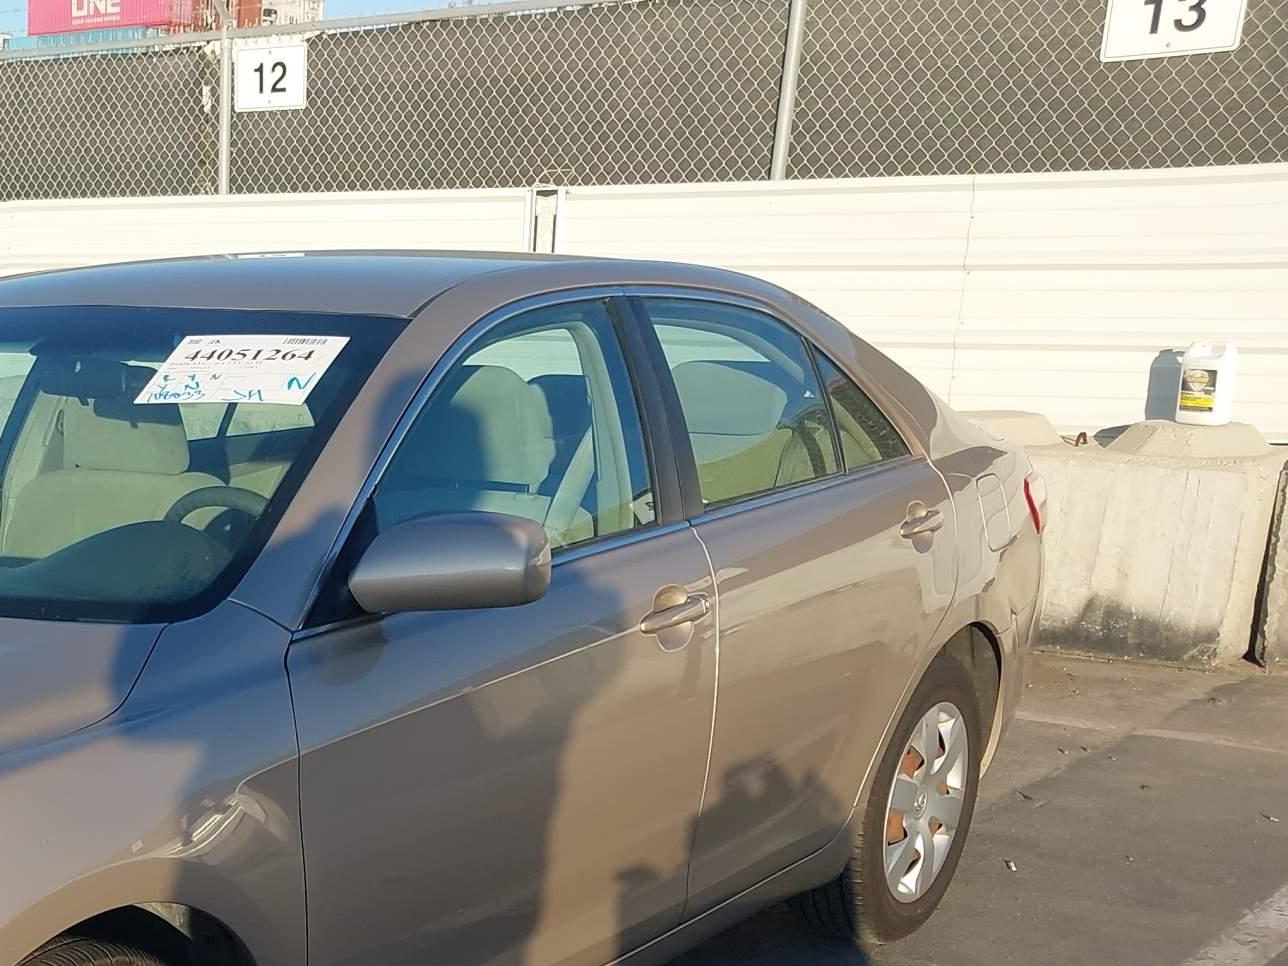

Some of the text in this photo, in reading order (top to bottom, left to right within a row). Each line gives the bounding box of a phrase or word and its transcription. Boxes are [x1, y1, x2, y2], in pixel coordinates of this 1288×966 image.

[1143, 0, 1208, 35] 13
[253, 61, 287, 95] 12
[184, 348, 315, 361] 44051264
[286, 371, 317, 391] N
